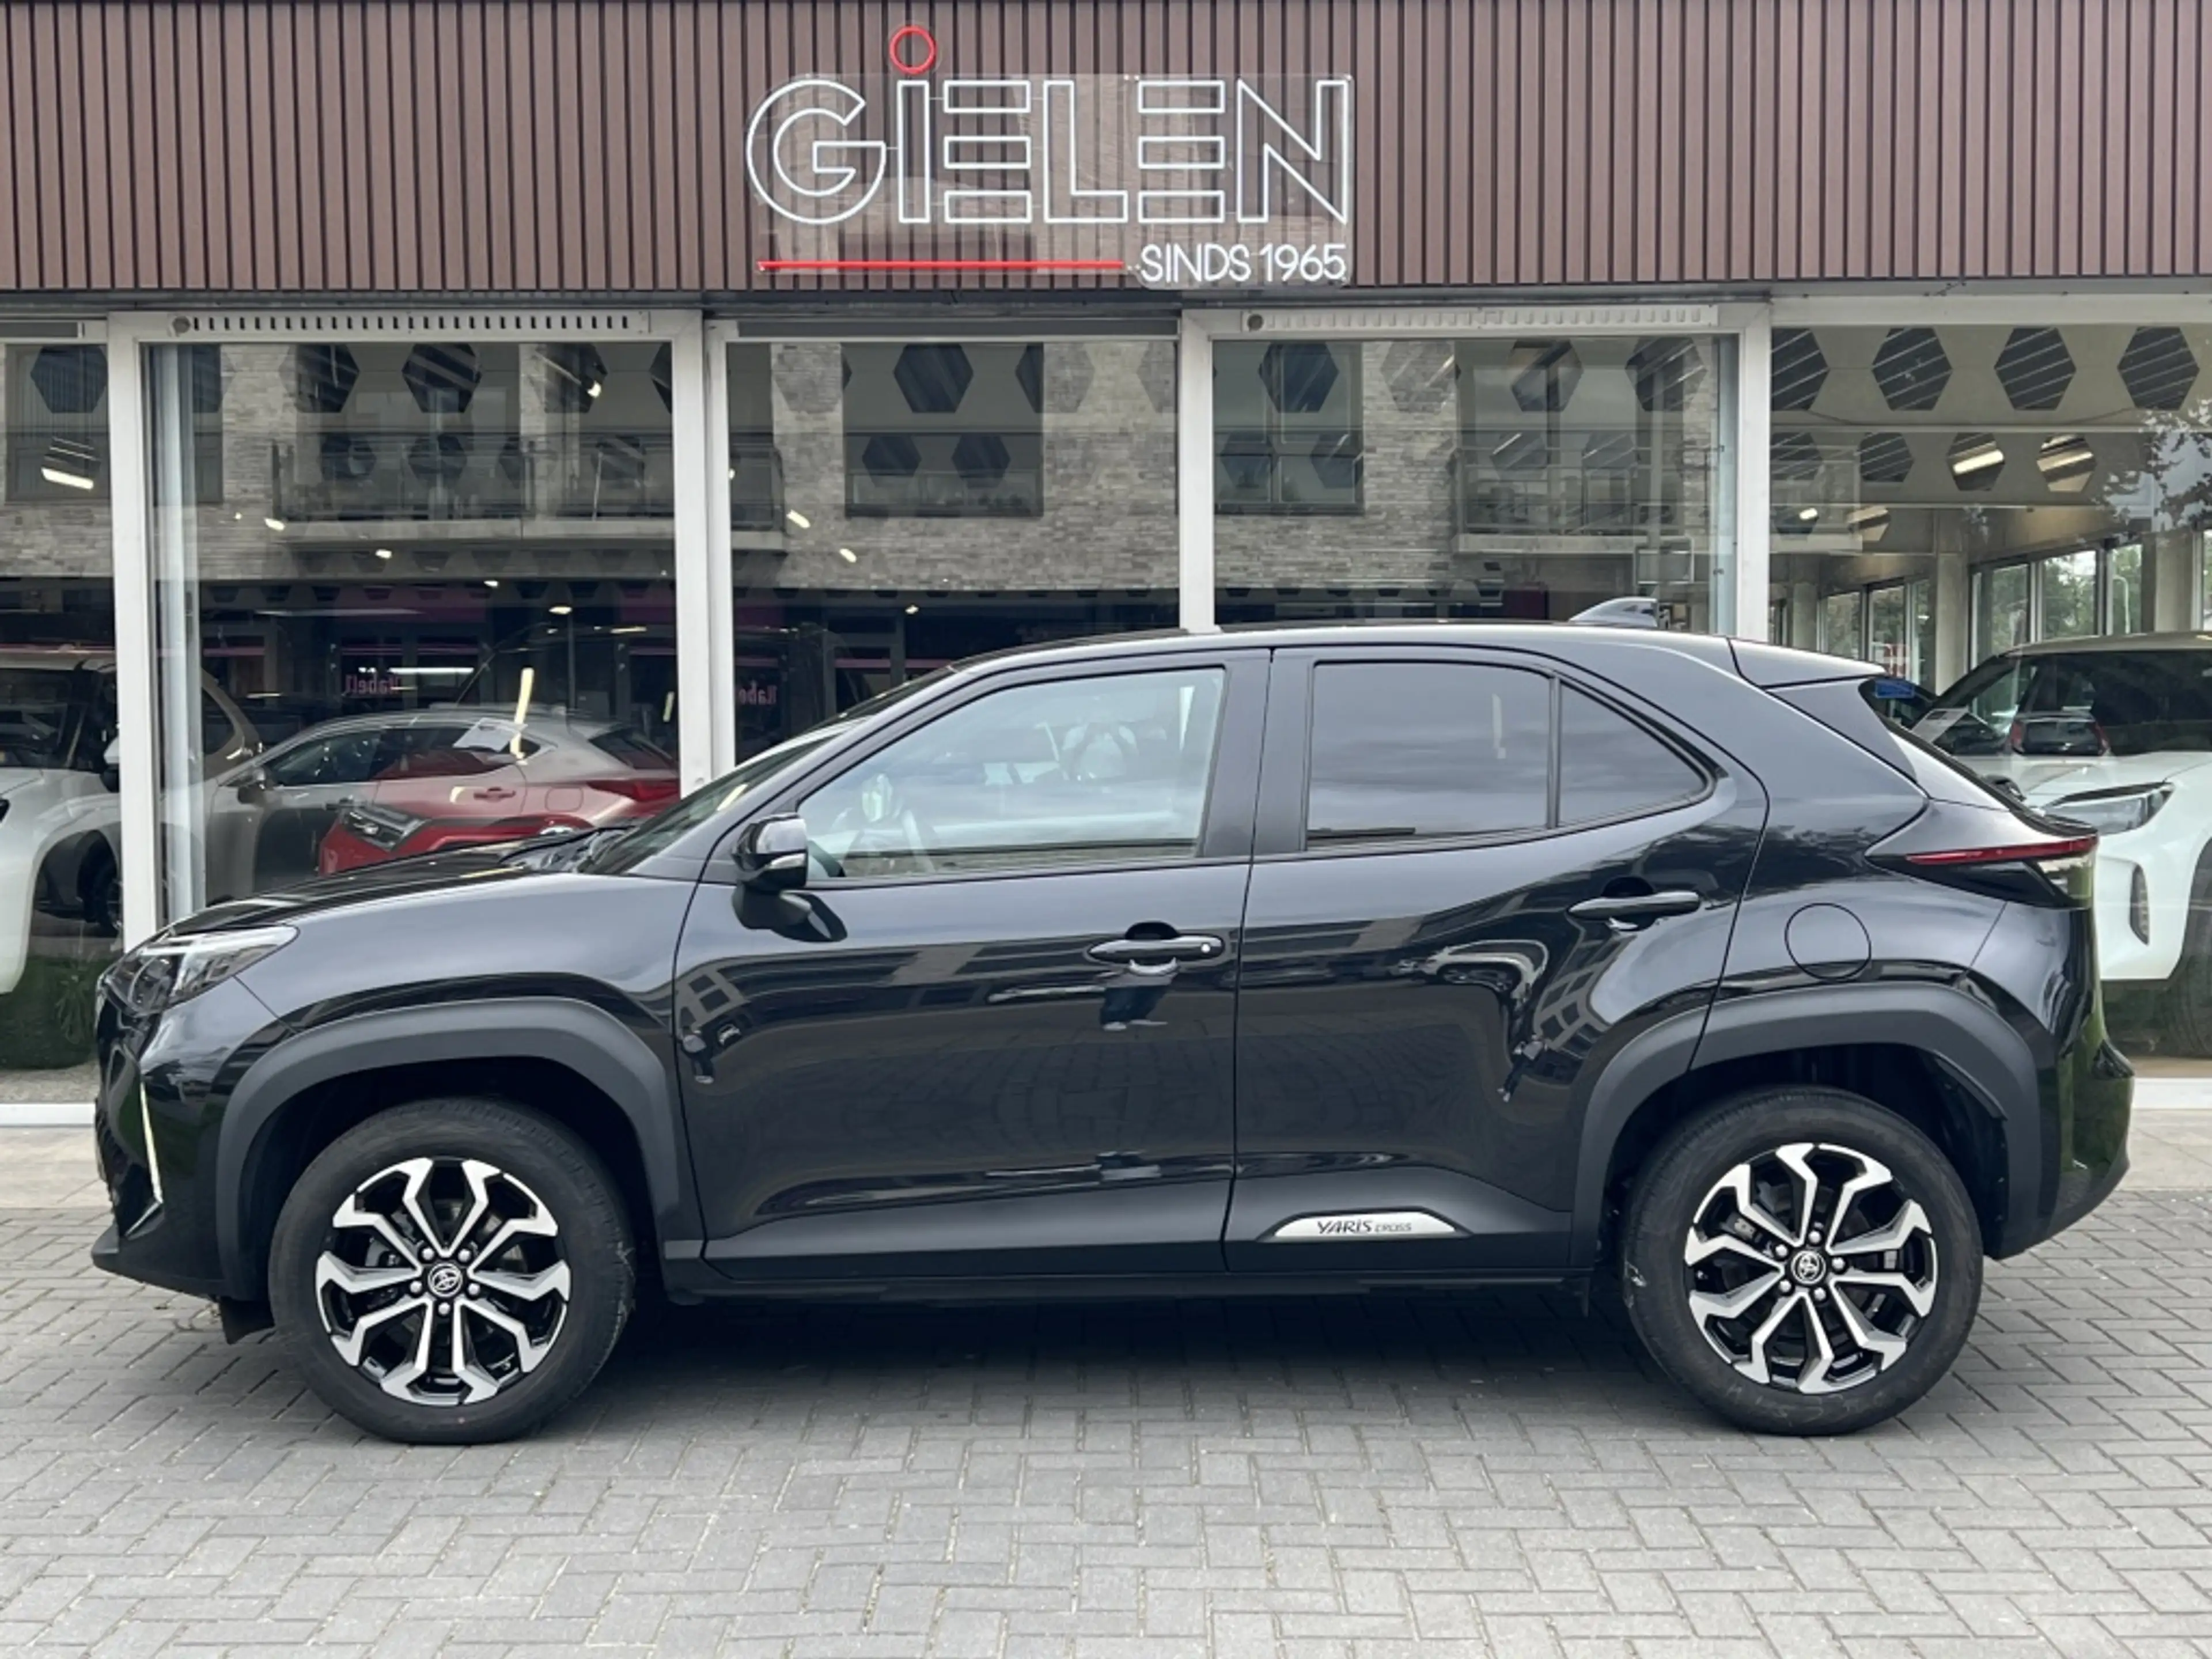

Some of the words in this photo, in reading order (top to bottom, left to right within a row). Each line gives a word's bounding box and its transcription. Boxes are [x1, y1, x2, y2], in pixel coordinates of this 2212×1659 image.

[1140, 243, 1251, 282] SINDS
[1260, 243, 1346, 282] 1965
[1317, 1219, 1373, 1234] YARIS
